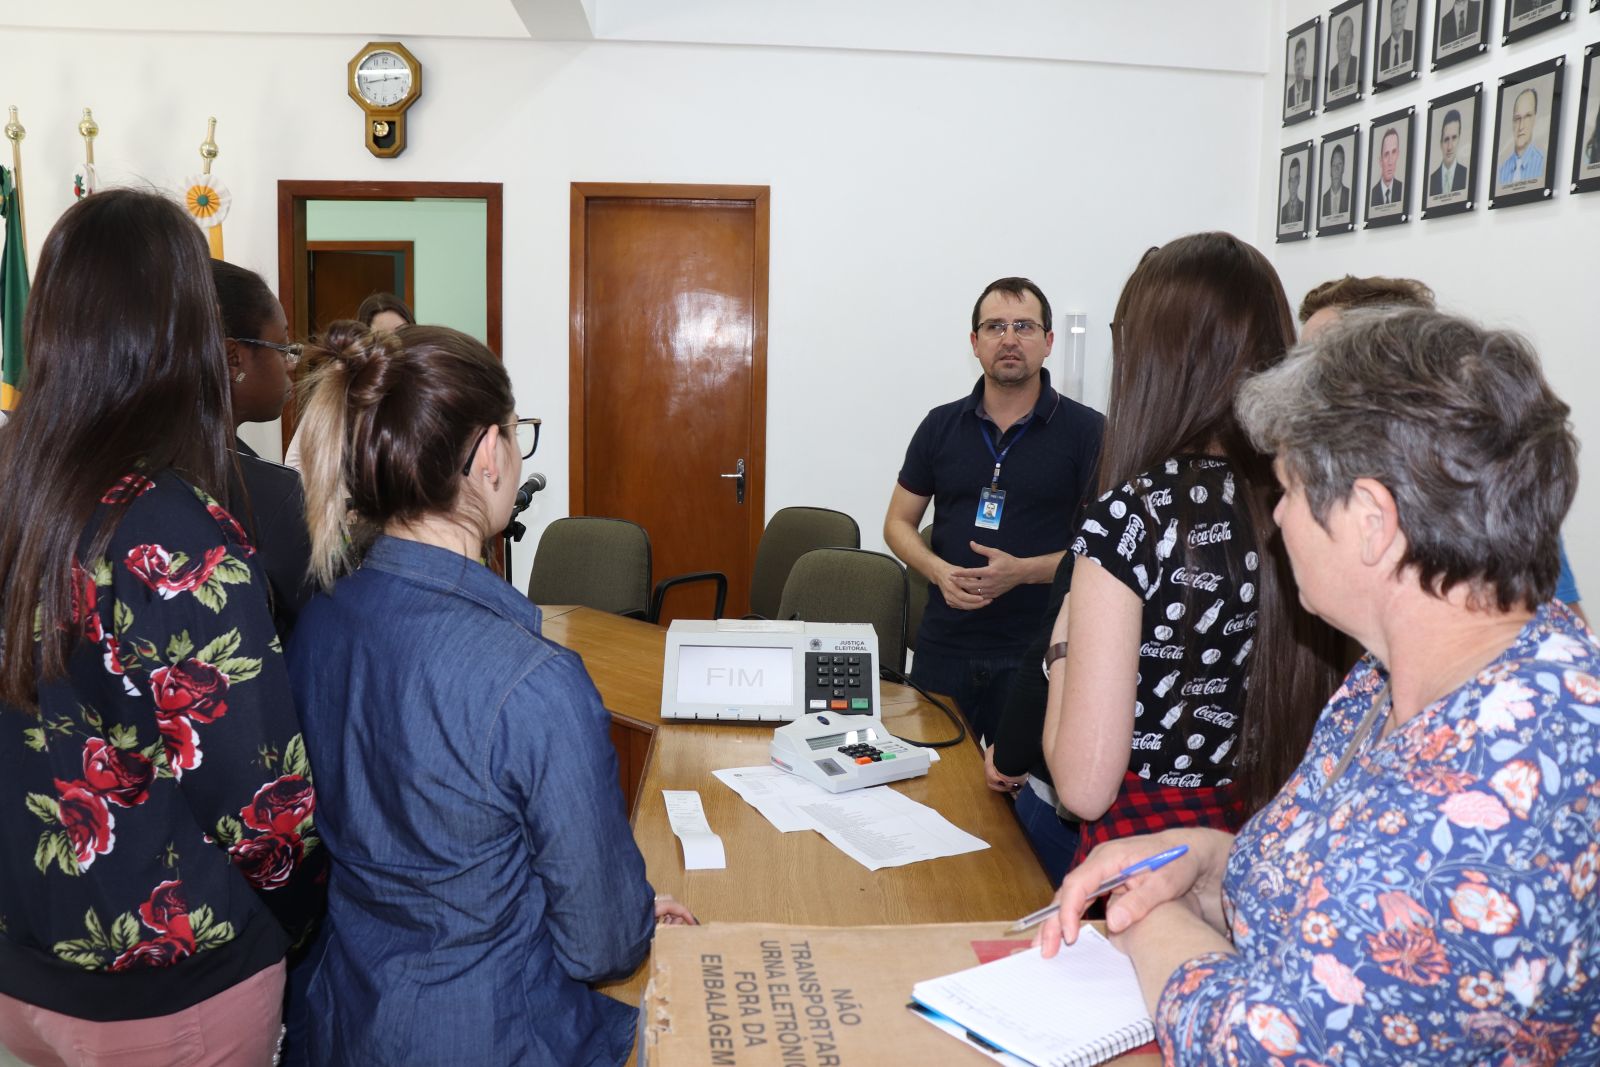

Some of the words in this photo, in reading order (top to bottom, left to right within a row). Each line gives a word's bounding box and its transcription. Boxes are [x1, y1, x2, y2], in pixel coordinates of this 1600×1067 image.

[706, 667, 764, 688] FIM
[760, 940, 786, 980] URNA
[701, 954, 736, 1066] EMBALAGEM
[734, 971, 762, 1018] FORA
[790, 940, 841, 1067] TRANSPORTAR
[831, 988, 863, 1026] NÃO
[742, 1023, 768, 1047] DA
[768, 983, 808, 1067] ELETRÔNIC
